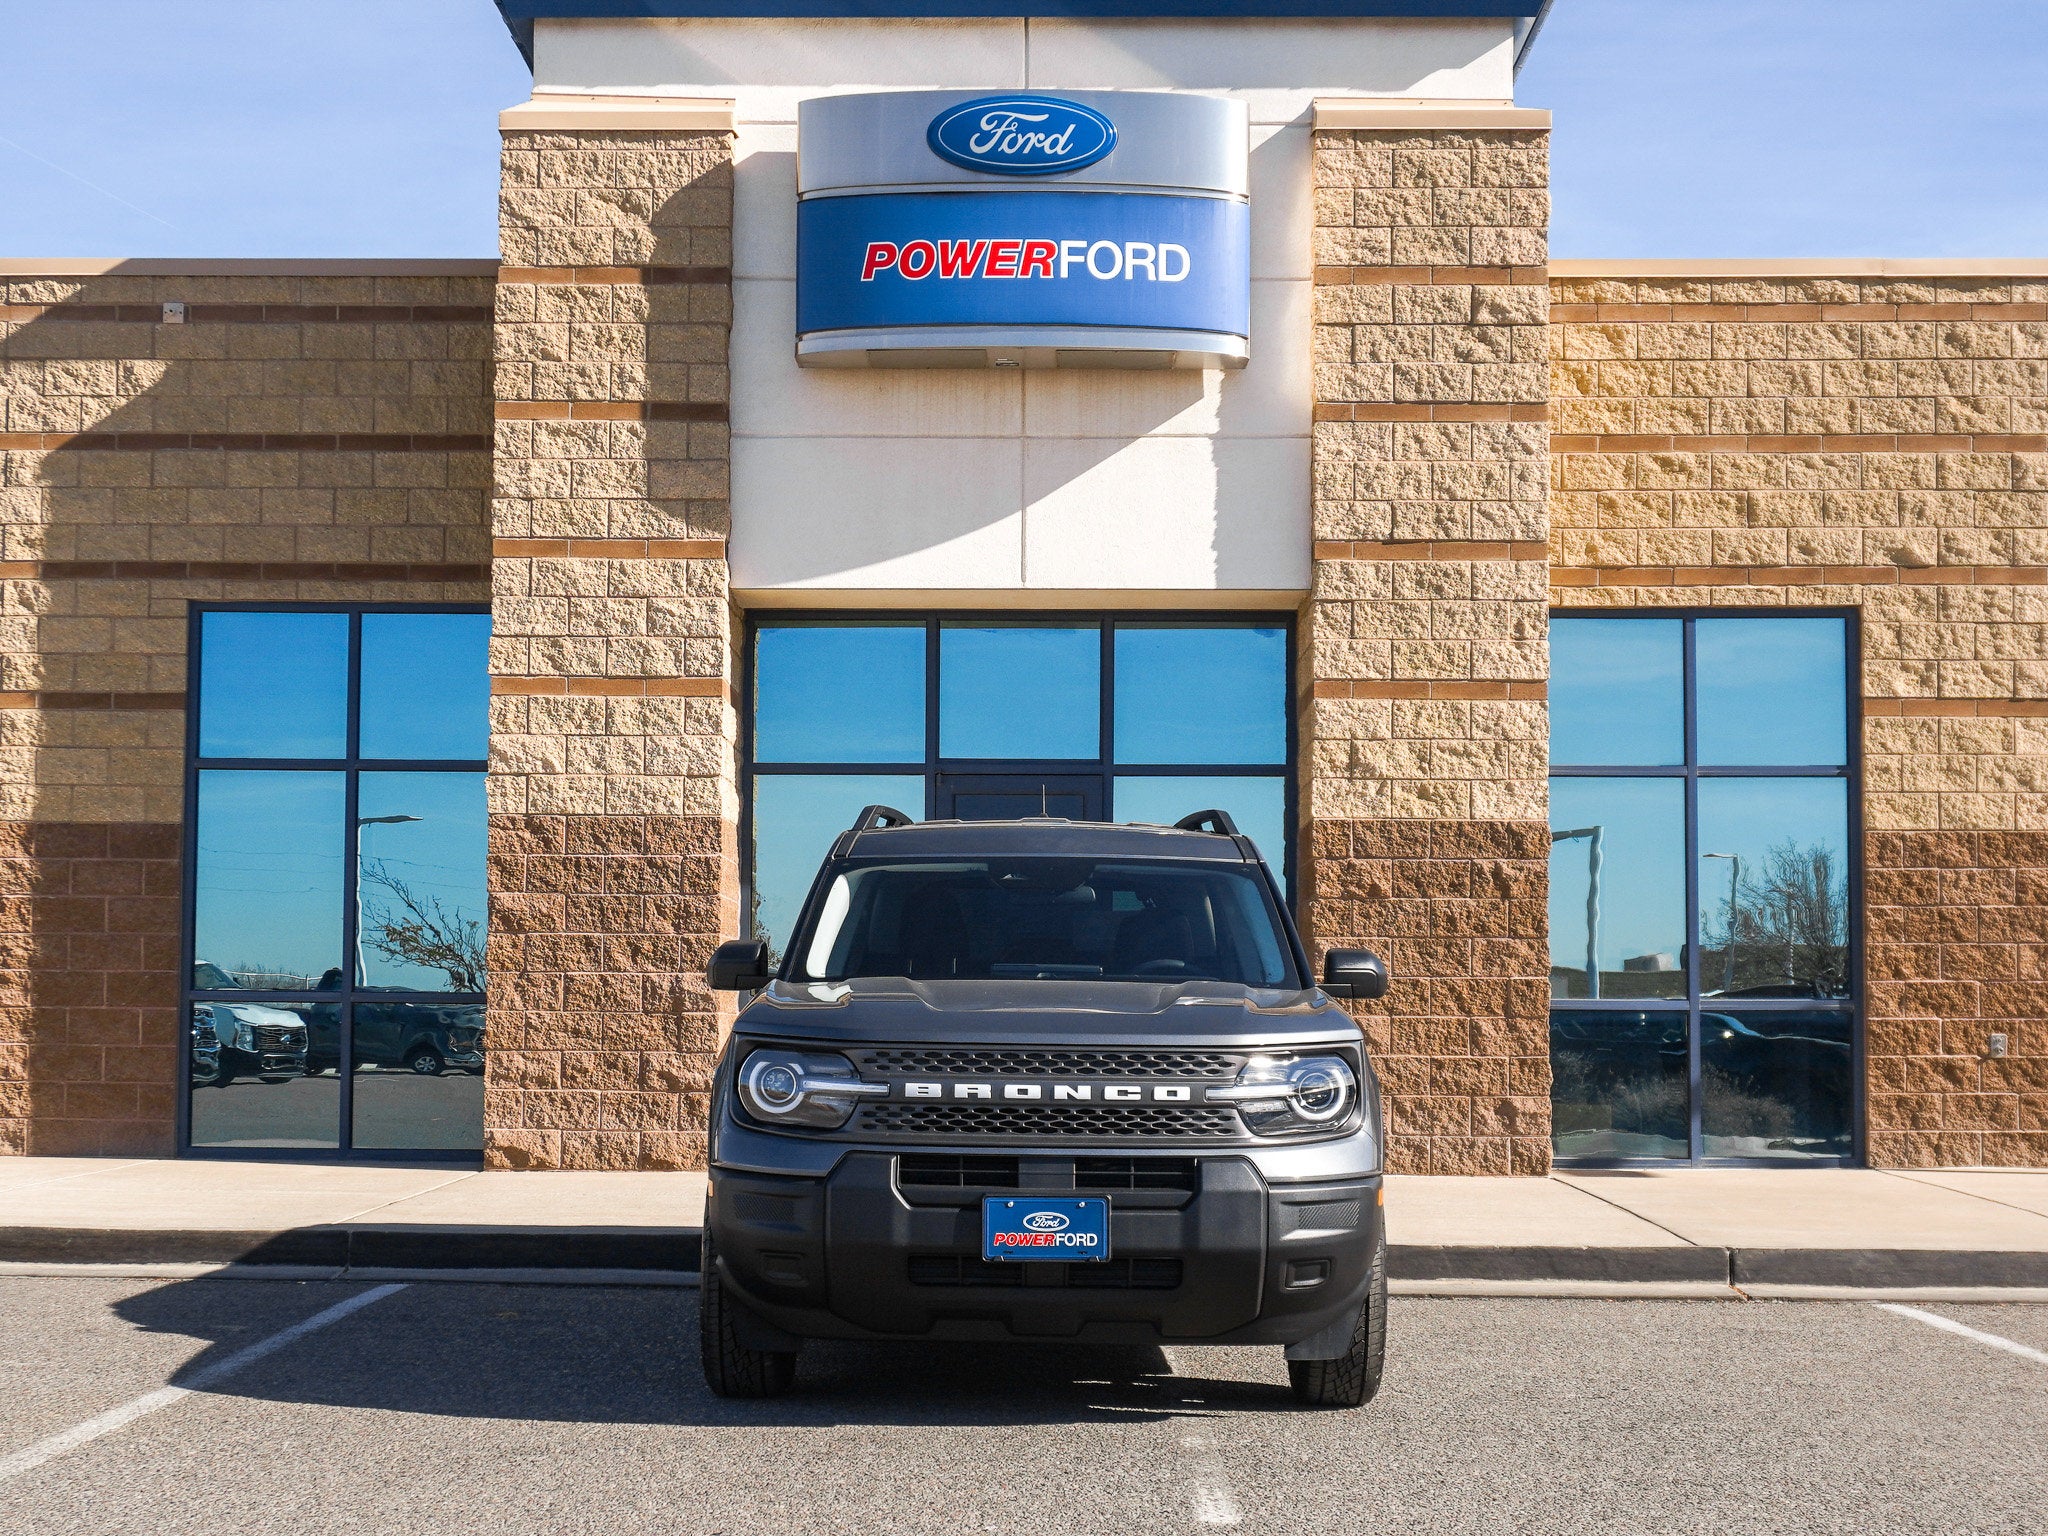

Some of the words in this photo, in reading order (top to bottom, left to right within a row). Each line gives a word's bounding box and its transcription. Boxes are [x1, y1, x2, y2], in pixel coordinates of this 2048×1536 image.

[969, 111, 1077, 156] Ford
[904, 1081, 1192, 1102] BRONCO
[1031, 1215, 1060, 1228] Ford
